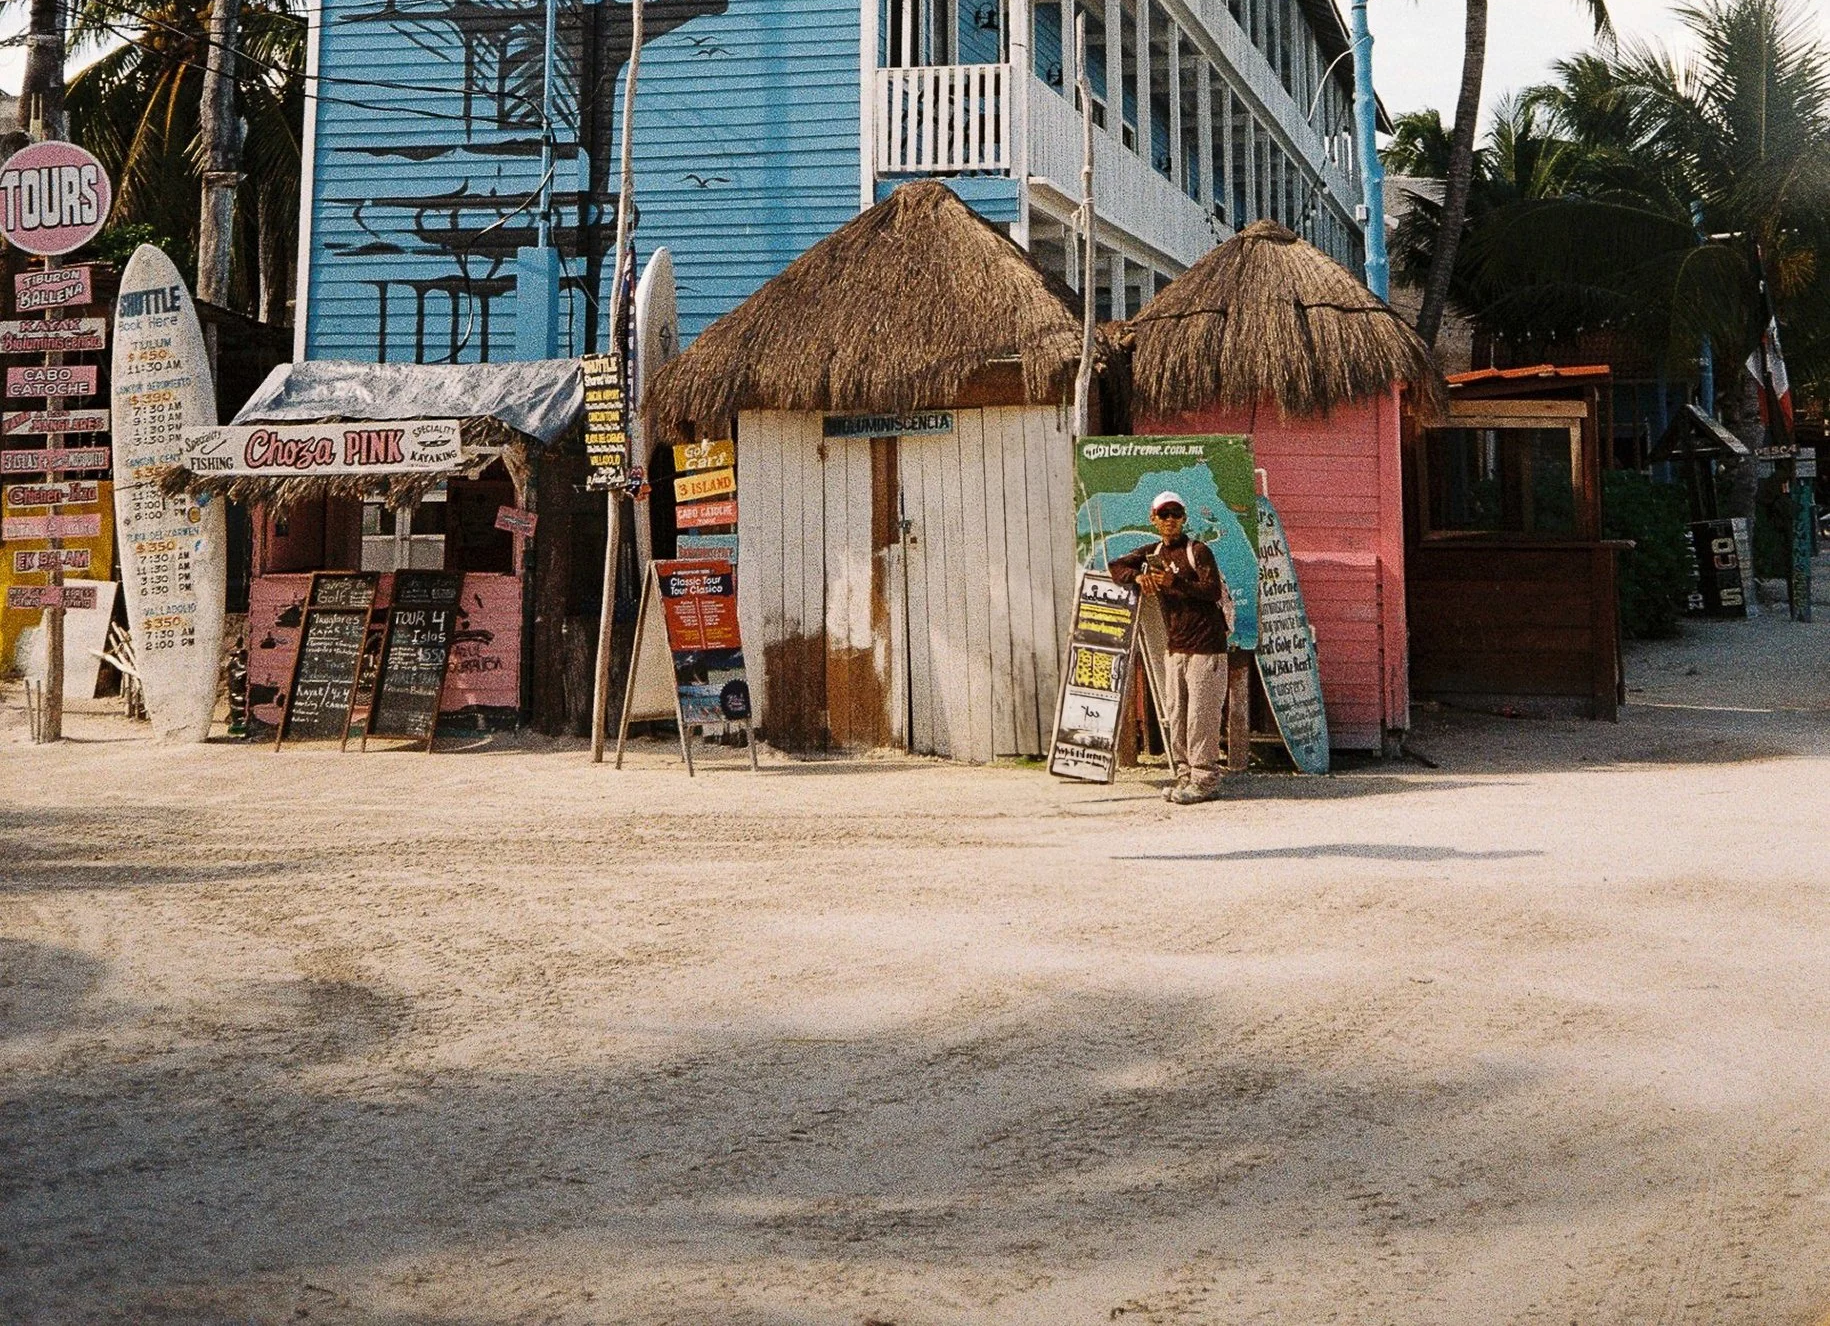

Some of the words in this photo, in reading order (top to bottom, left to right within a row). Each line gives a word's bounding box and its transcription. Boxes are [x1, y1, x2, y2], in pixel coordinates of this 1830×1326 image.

[2, 165, 99, 231] TOURS
[23, 270, 80, 288] TIBURON
[18, 282, 84, 309] BALLENA
[165, 359, 182, 370] AM
[24, 368, 72, 382] CABO
[10, 382, 90, 395] CATOCHE
[132, 404, 165, 416] 7:30
[244, 429, 336, 469] Choza
[344, 429, 405, 466] PINK
[190, 457, 234, 471] FISHING
[409, 450, 458, 464] KAYAKING
[679, 483, 688, 496] 3
[691, 476, 732, 495] ISLAND
[670, 576, 701, 587] Classic
[702, 576, 722, 585] Tour
[670, 585, 688, 596] Tour
[689, 585, 723, 595] Clasico
[395, 611, 426, 627] TOUR
[431, 610, 447, 632] 4
